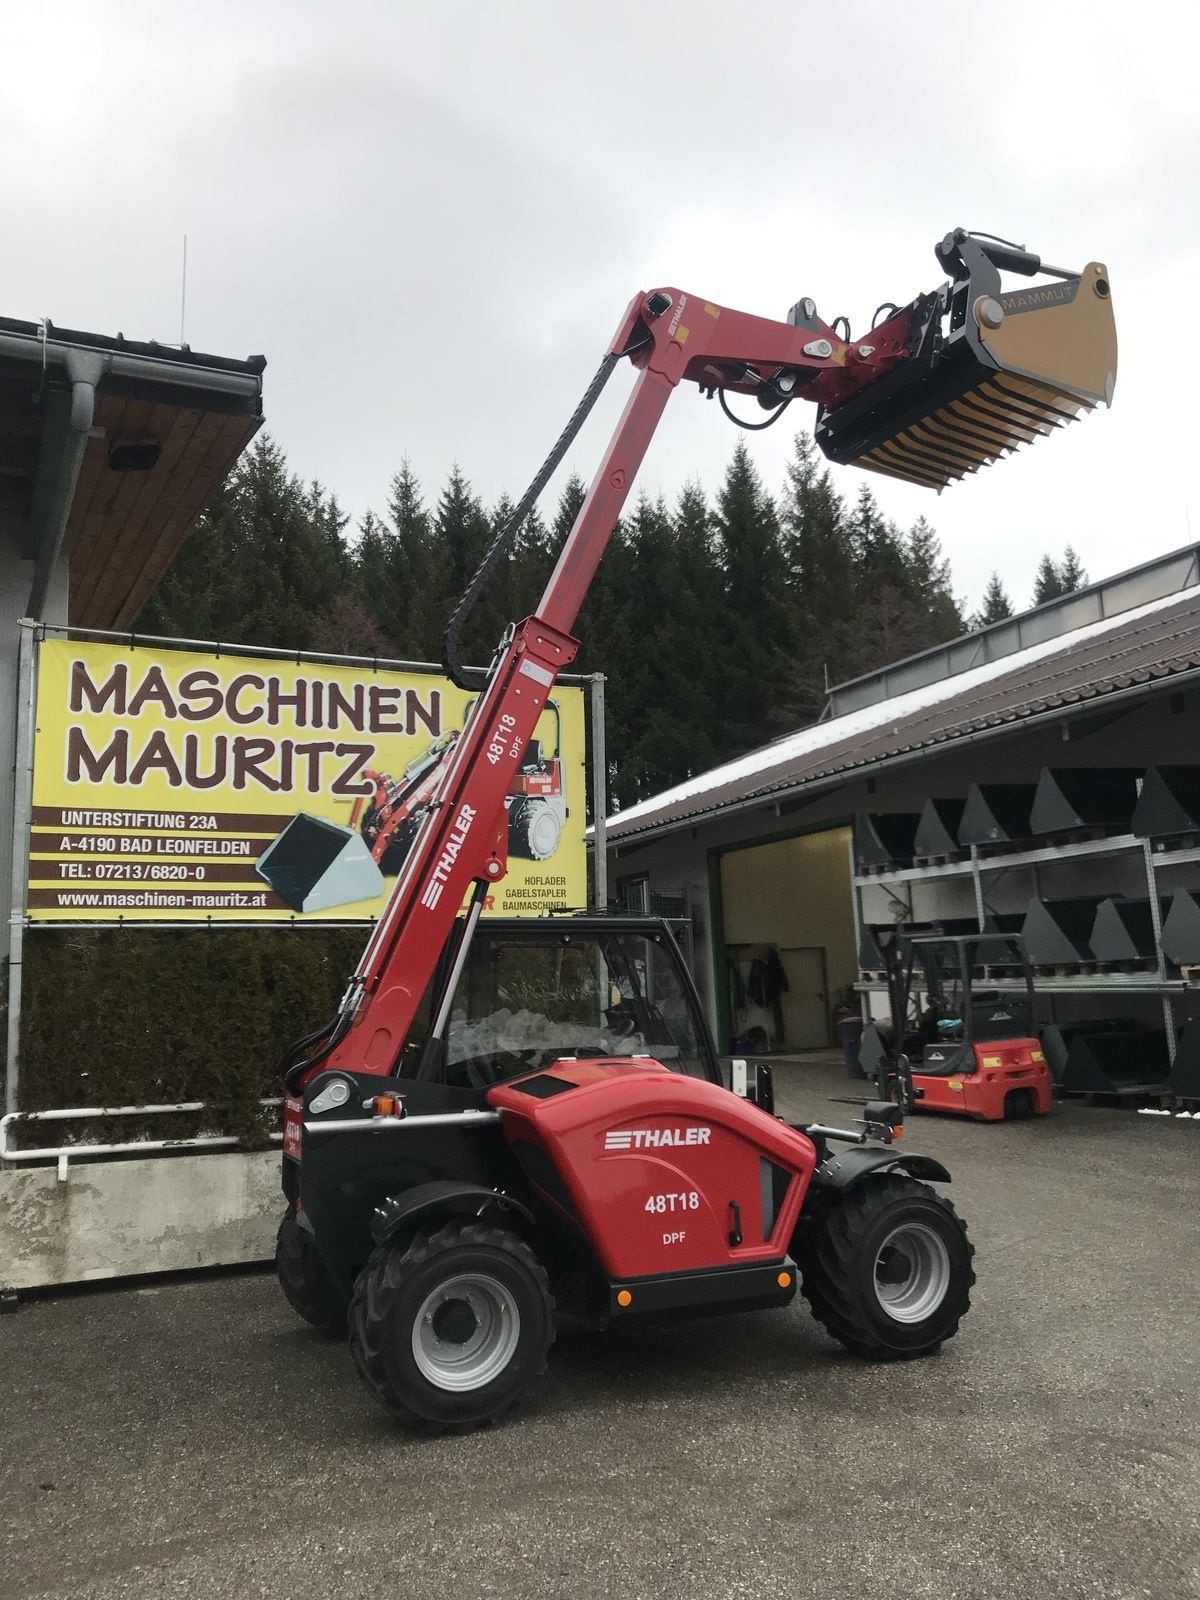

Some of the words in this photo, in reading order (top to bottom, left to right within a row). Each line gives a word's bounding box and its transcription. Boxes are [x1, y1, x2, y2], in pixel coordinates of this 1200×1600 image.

[1002, 286, 1072, 310] MAMMUT
[69, 660, 442, 737] MASCHINEN
[486, 713, 517, 765] 48T18
[509, 735, 523, 759] DPF
[66, 726, 375, 795] MAURITZ
[61, 810, 186, 829] UNTERSTIFTUNG
[189, 815, 218, 830] 23A
[59, 836, 116, 852] A-4190
[120, 838, 152, 853] BAD
[156, 839, 250, 855] LEONFELDEN
[58, 863, 92, 878] TEL:
[95, 864, 206, 880] 07213/6820-0
[524, 876, 566, 886] HOFLADER
[57, 892, 267, 907] www.maschinen-mauritz.at
[505, 888, 567, 898] GABELSTAPLER
[502, 901, 567, 911] BAUMASCHINEN
[644, 1191, 700, 1214] 48T18
[662, 1231, 686, 1245] DPF
